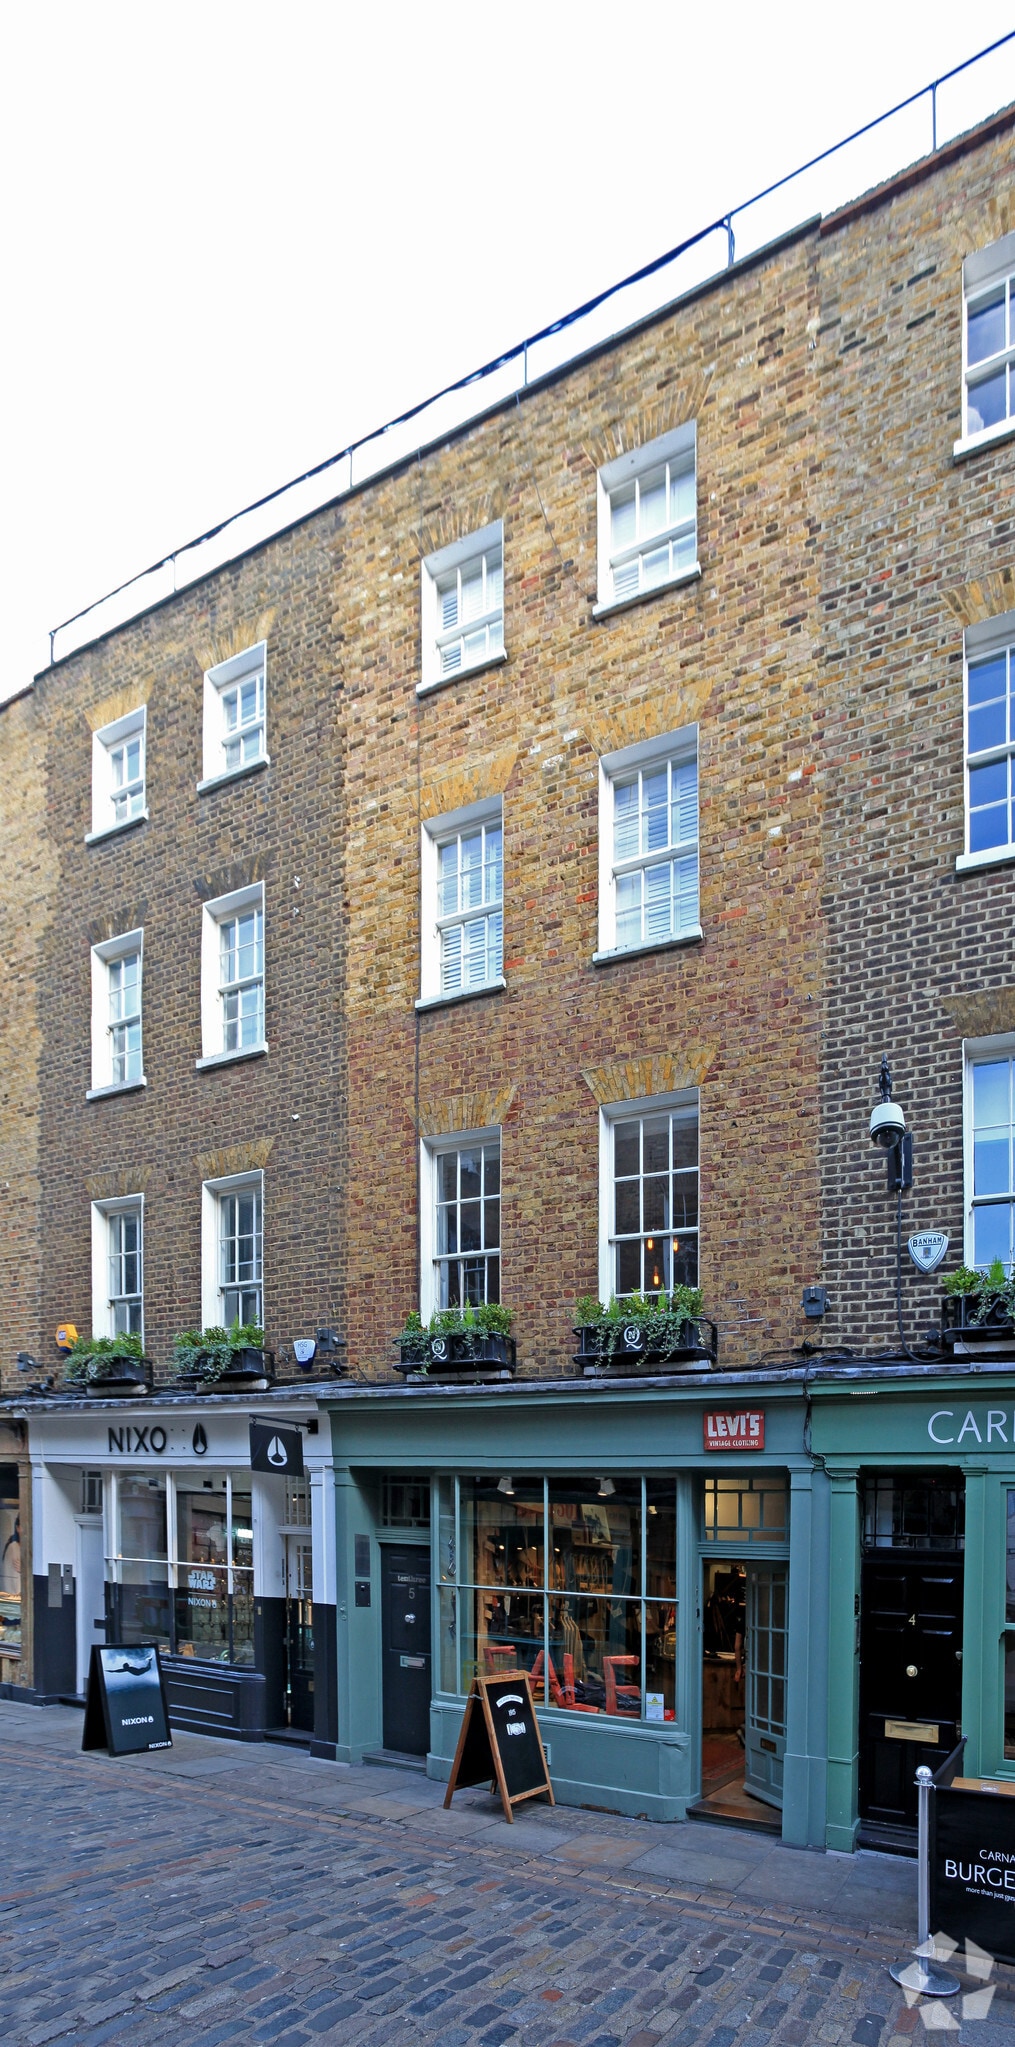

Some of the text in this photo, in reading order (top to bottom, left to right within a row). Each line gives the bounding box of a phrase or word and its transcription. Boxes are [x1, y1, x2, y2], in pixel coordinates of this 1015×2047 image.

[912, 1236, 942, 1247] BANHAM
[707, 1412, 760, 1437] LEVI'S
[927, 1410, 1015, 1444] CAR
[108, 1426, 167, 1452] NIXO
[187, 1569, 216, 1580] STAR
[188, 1579, 216, 1591] WARS
[408, 1588, 416, 1600] 5
[188, 1598, 211, 1608] NIXON
[908, 1614, 916, 1625] 4
[121, 1716, 147, 1726] NIXON
[148, 1741, 168, 1749] NIXON
[945, 1859, 1015, 1890] BURGE
[981, 1889, 993, 1897] than
[994, 1891, 1004, 1899] just
